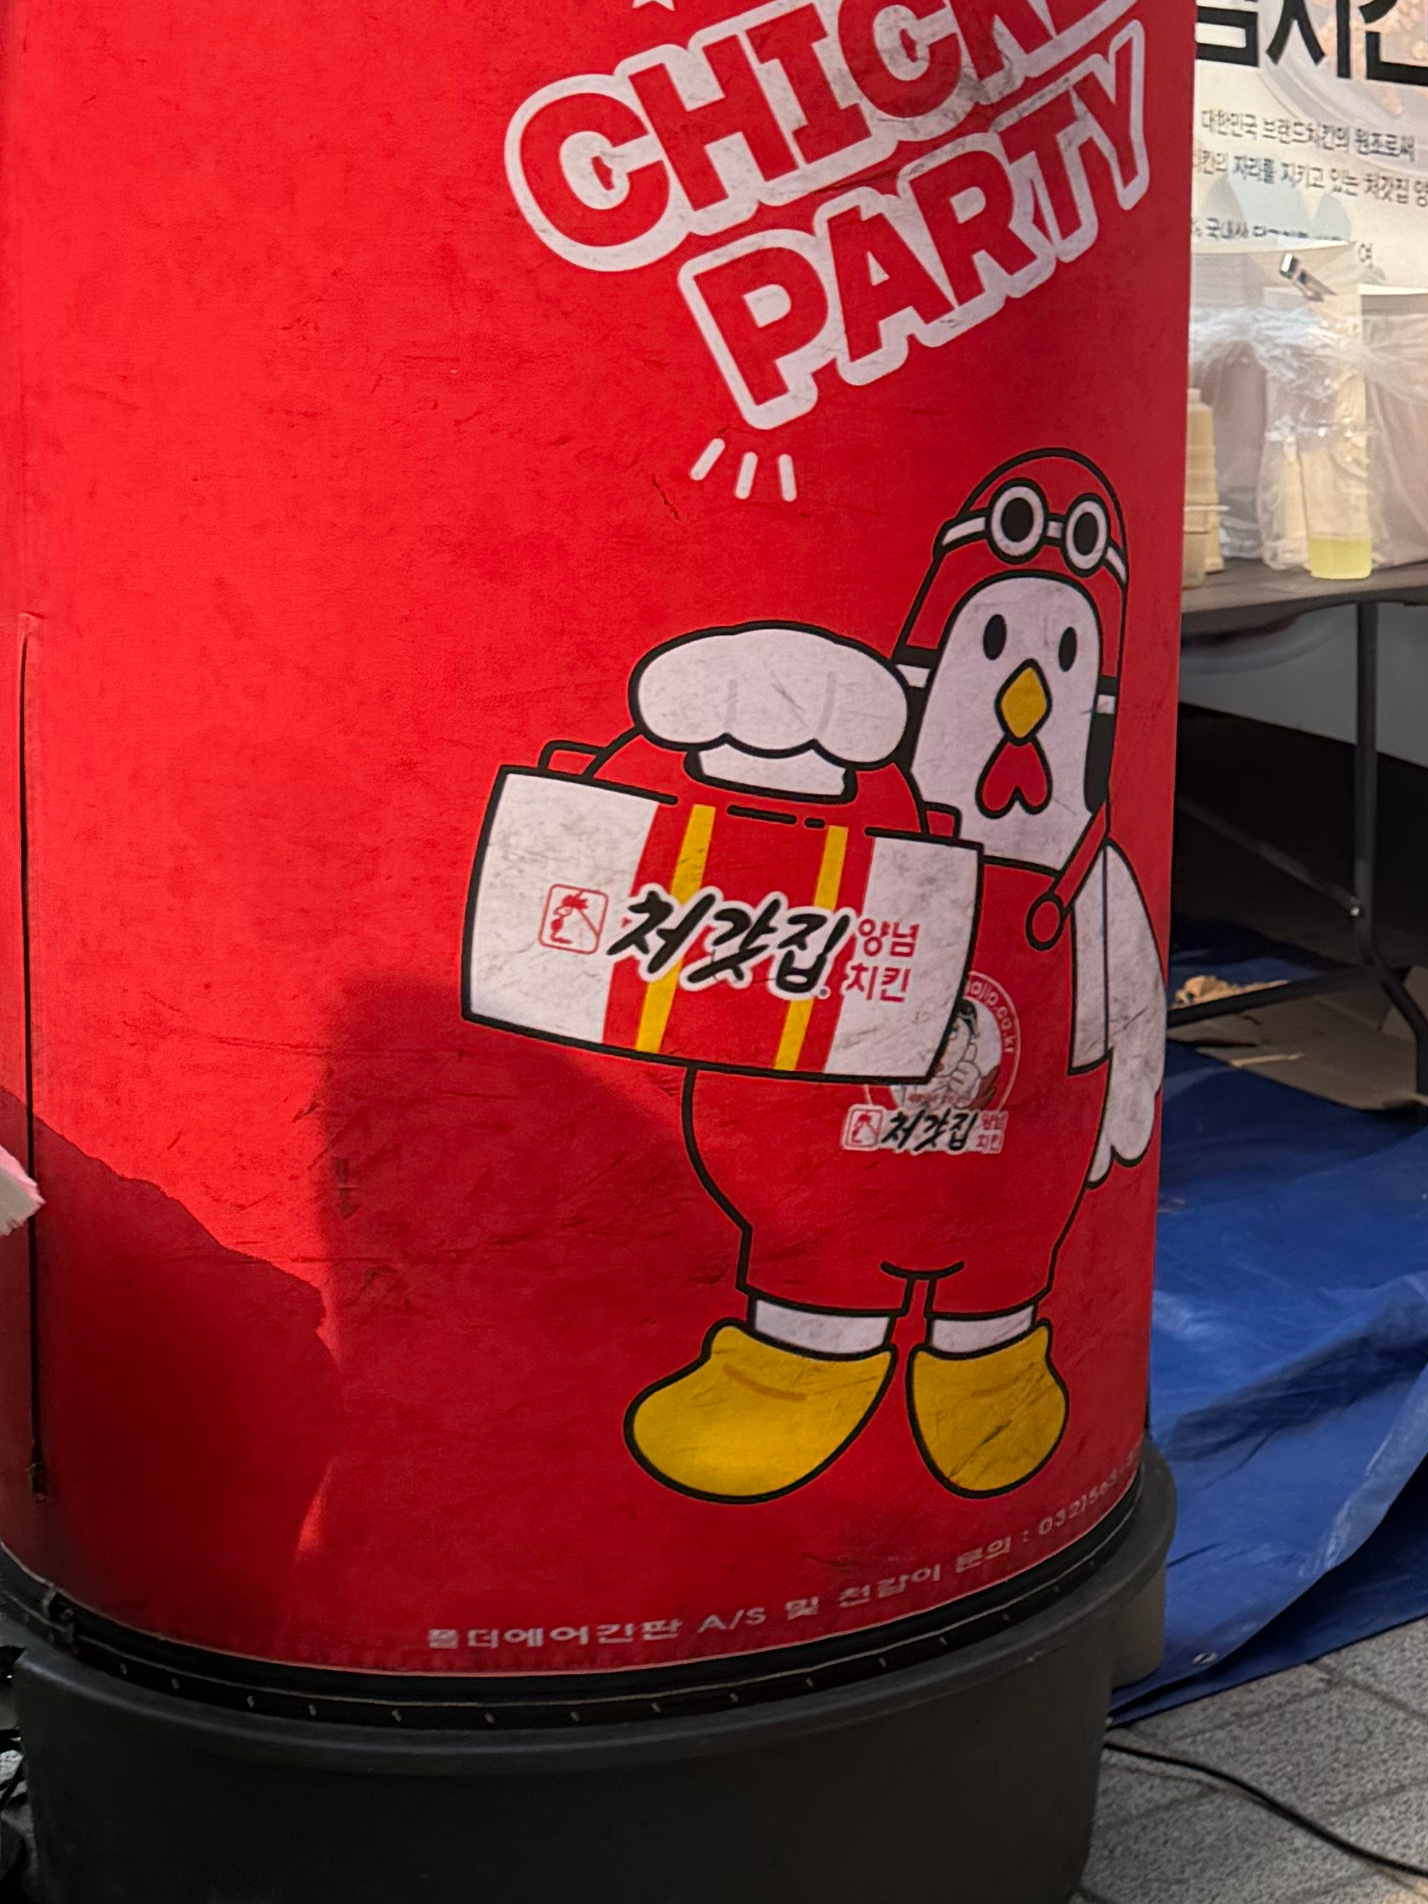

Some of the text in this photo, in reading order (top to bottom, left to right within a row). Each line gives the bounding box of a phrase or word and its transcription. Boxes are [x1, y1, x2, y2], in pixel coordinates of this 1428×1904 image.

[682, 24, 1145, 420] PARTY
[606, 890, 852, 994] 처갓집
[855, 917, 920, 958] 양념
[844, 964, 912, 1005] 치킨
[880, 1108, 979, 1152] 처갓집
[697, 1607, 767, 1635] A/S
